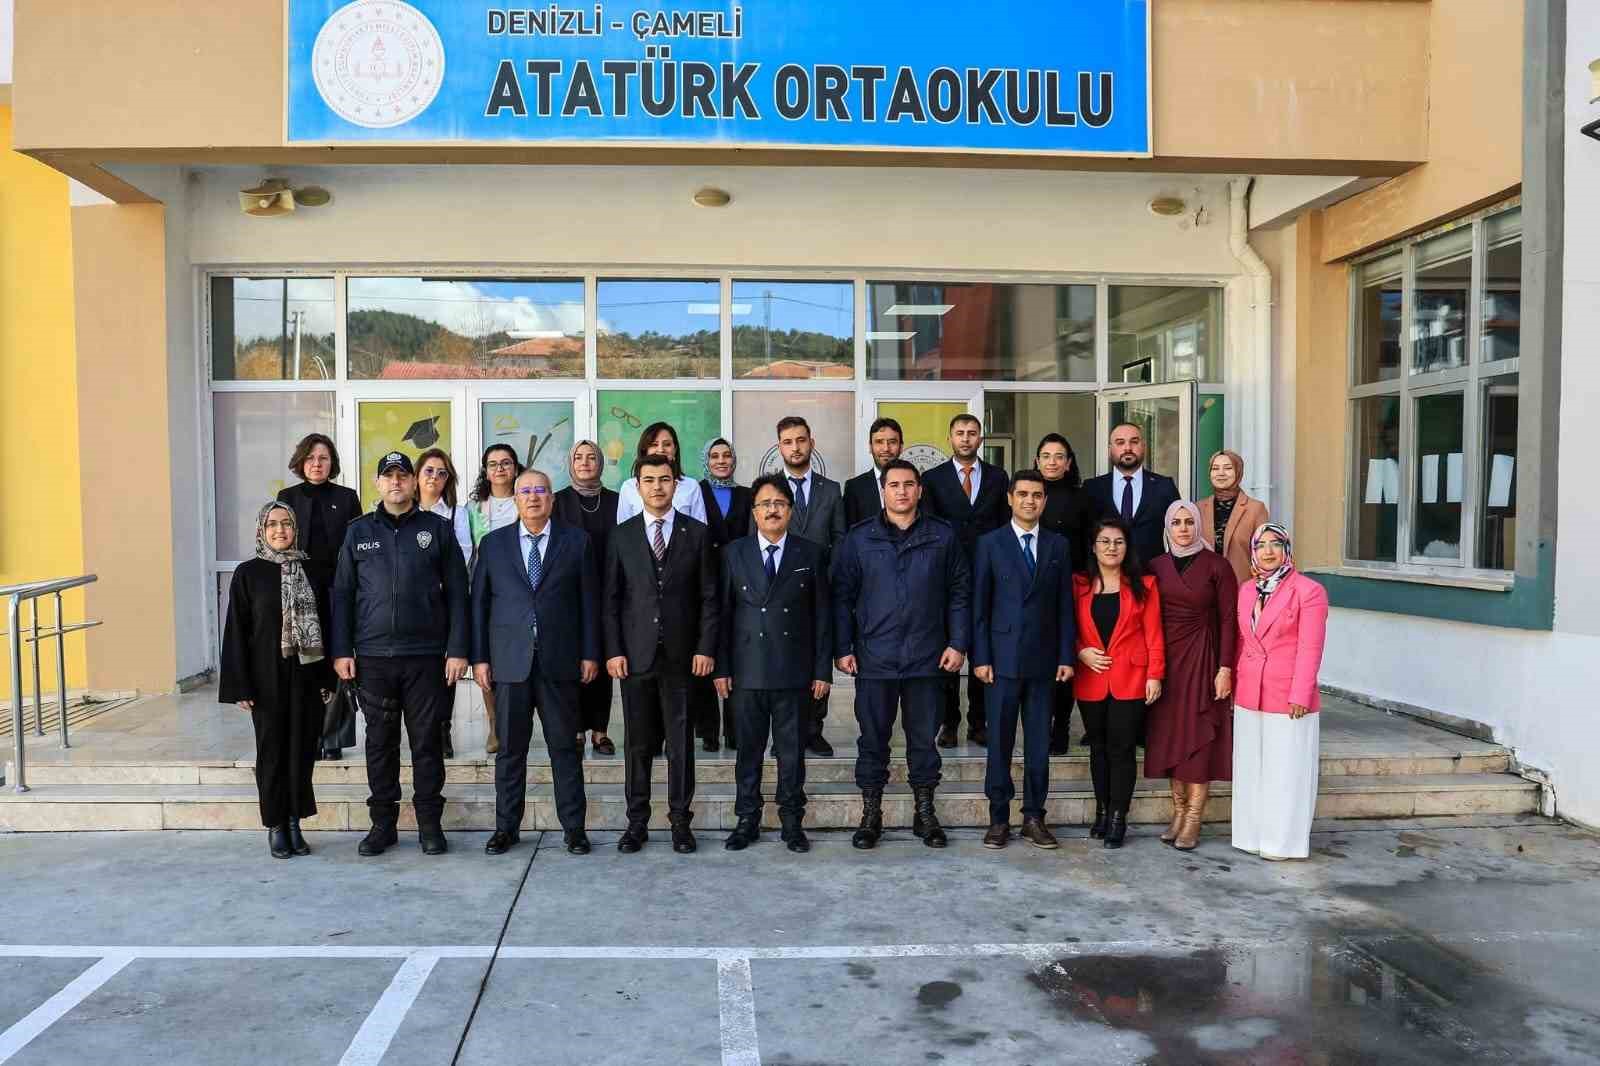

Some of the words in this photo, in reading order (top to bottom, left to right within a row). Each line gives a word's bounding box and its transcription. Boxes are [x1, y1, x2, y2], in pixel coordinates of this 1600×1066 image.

[488, 5, 602, 35] DENİZLİ
[611, 22, 624, 30] -
[632, 7, 742, 39] ÇAMELİ
[484, 45, 762, 119] ATATÜRK
[774, 63, 1114, 128] ORTAOKULU
